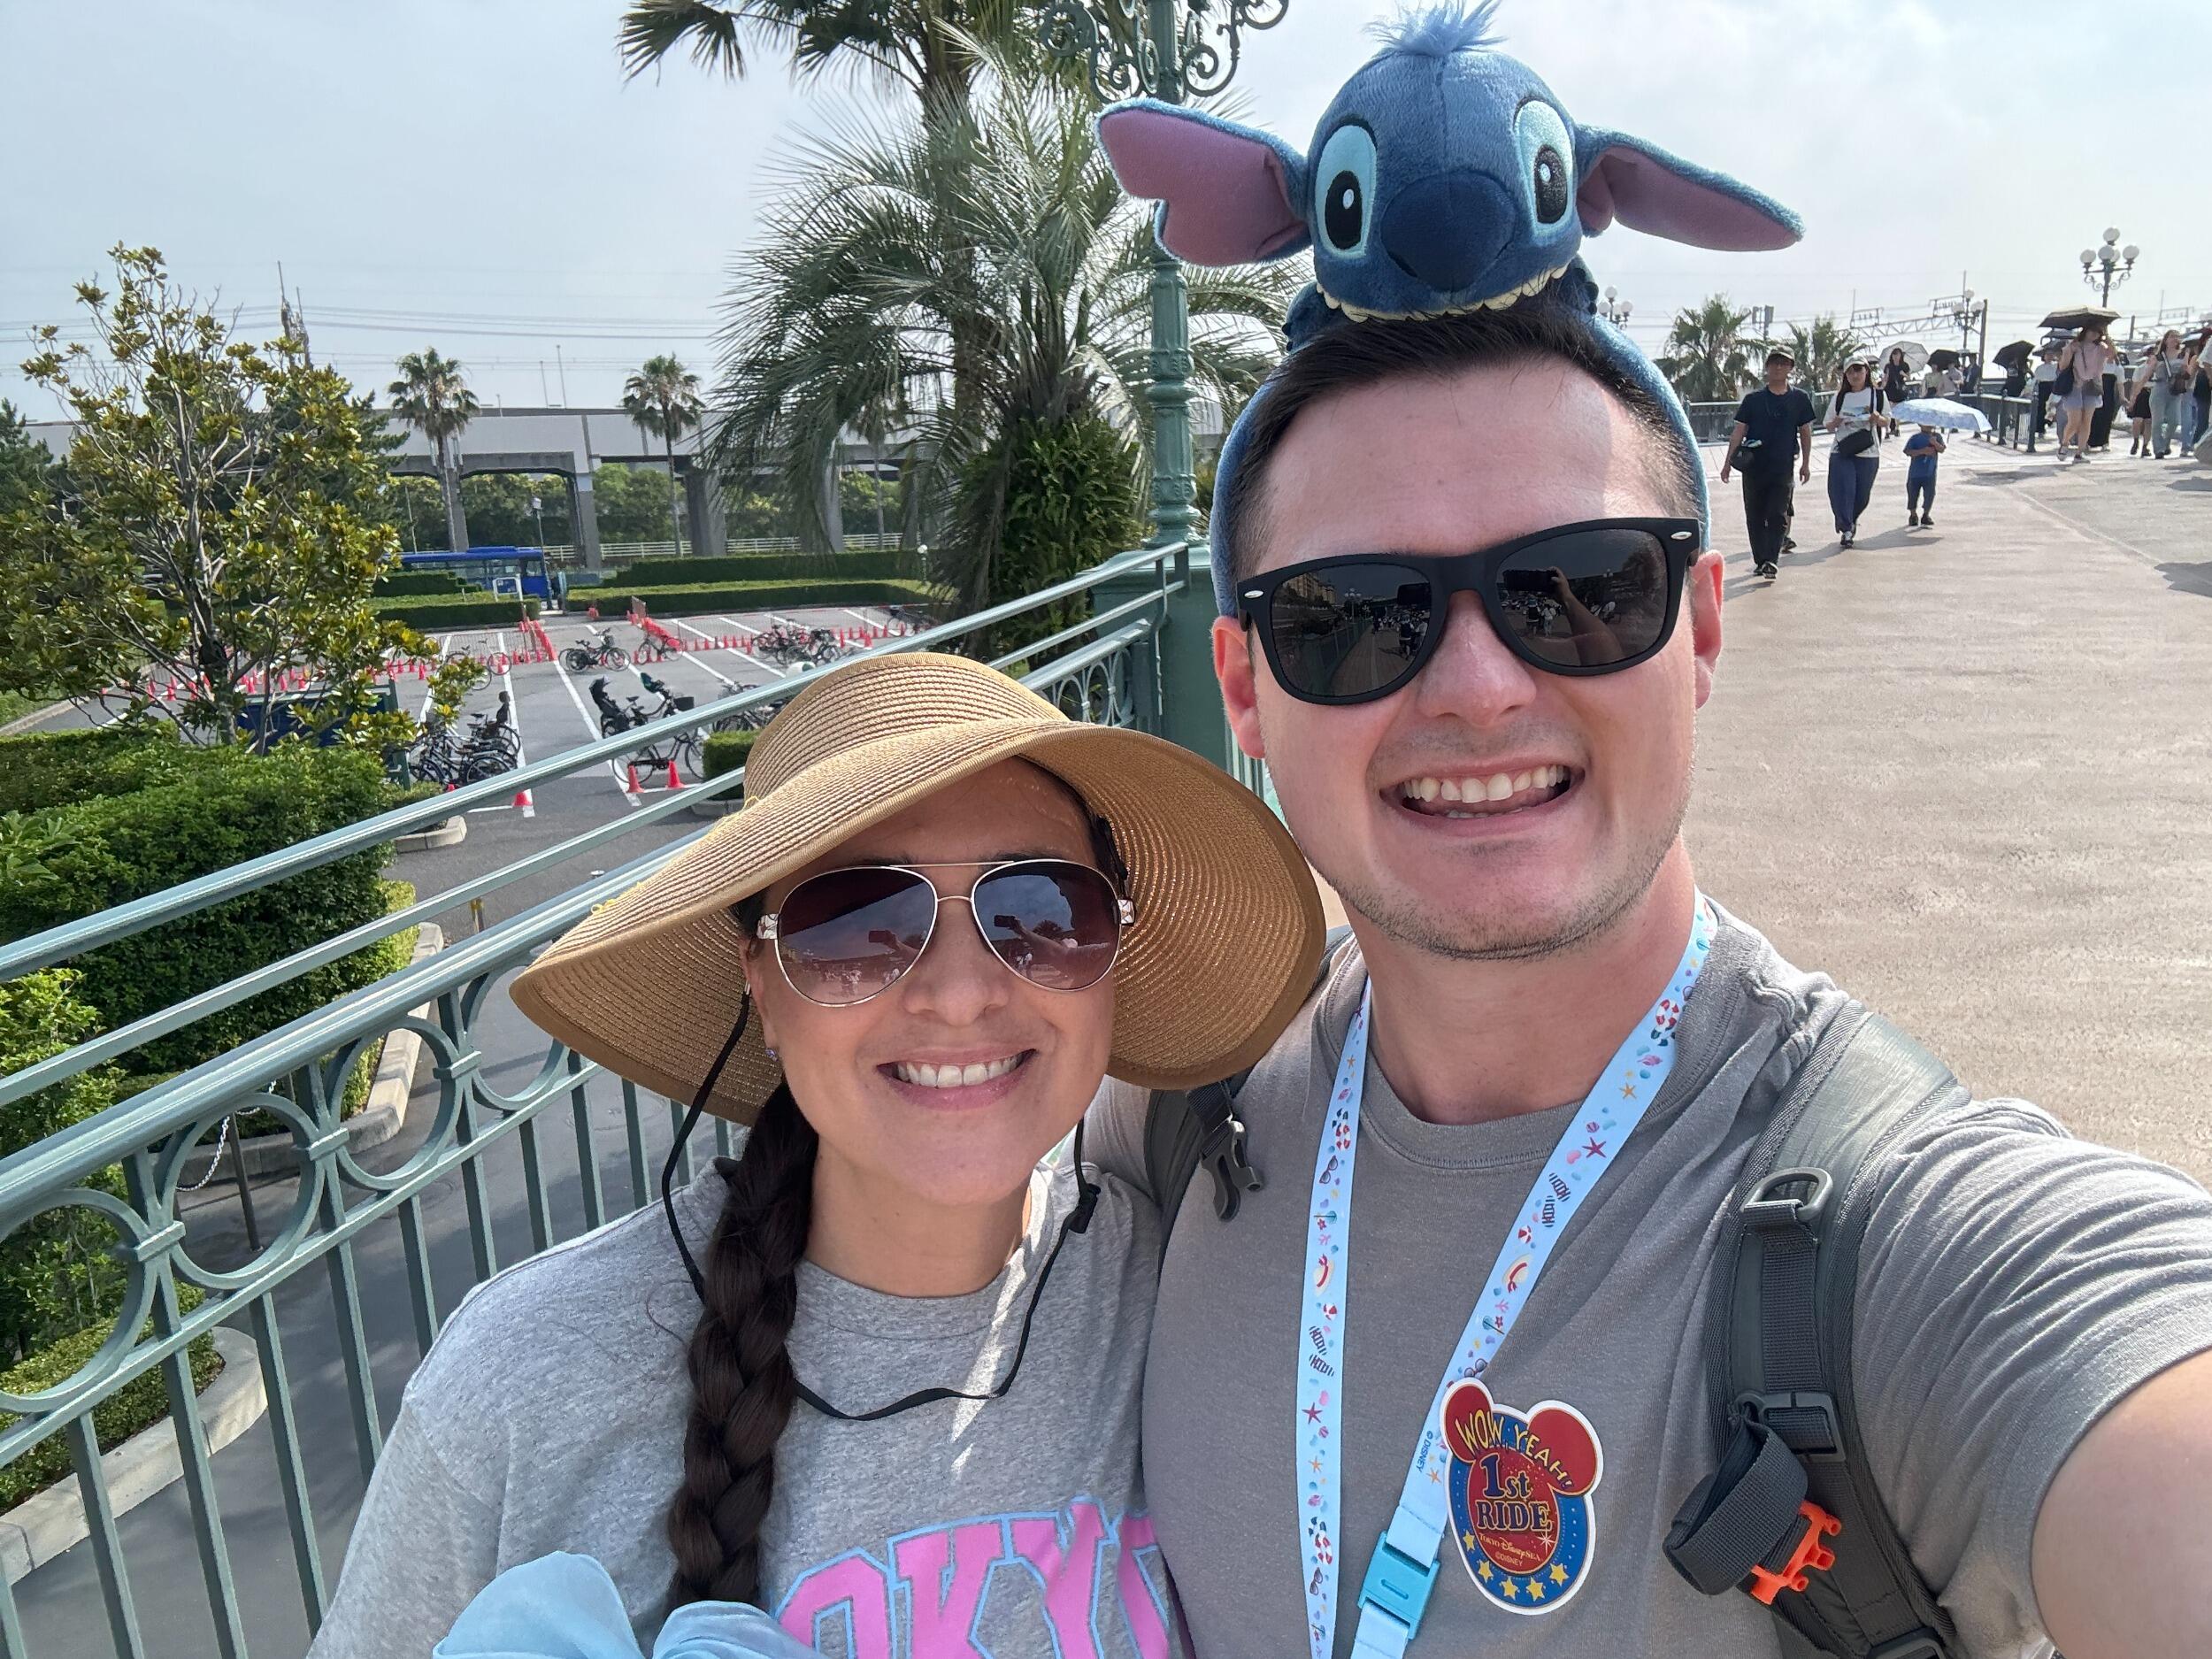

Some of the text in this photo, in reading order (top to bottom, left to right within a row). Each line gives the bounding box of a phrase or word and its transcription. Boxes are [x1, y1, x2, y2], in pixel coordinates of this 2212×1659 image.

[1416, 1439, 1432, 1473] DISNEY
[1479, 1452, 1532, 1499] 1st
[1514, 1423, 1572, 1488] YEAH!
[1475, 1500, 1553, 1532] RIDE
